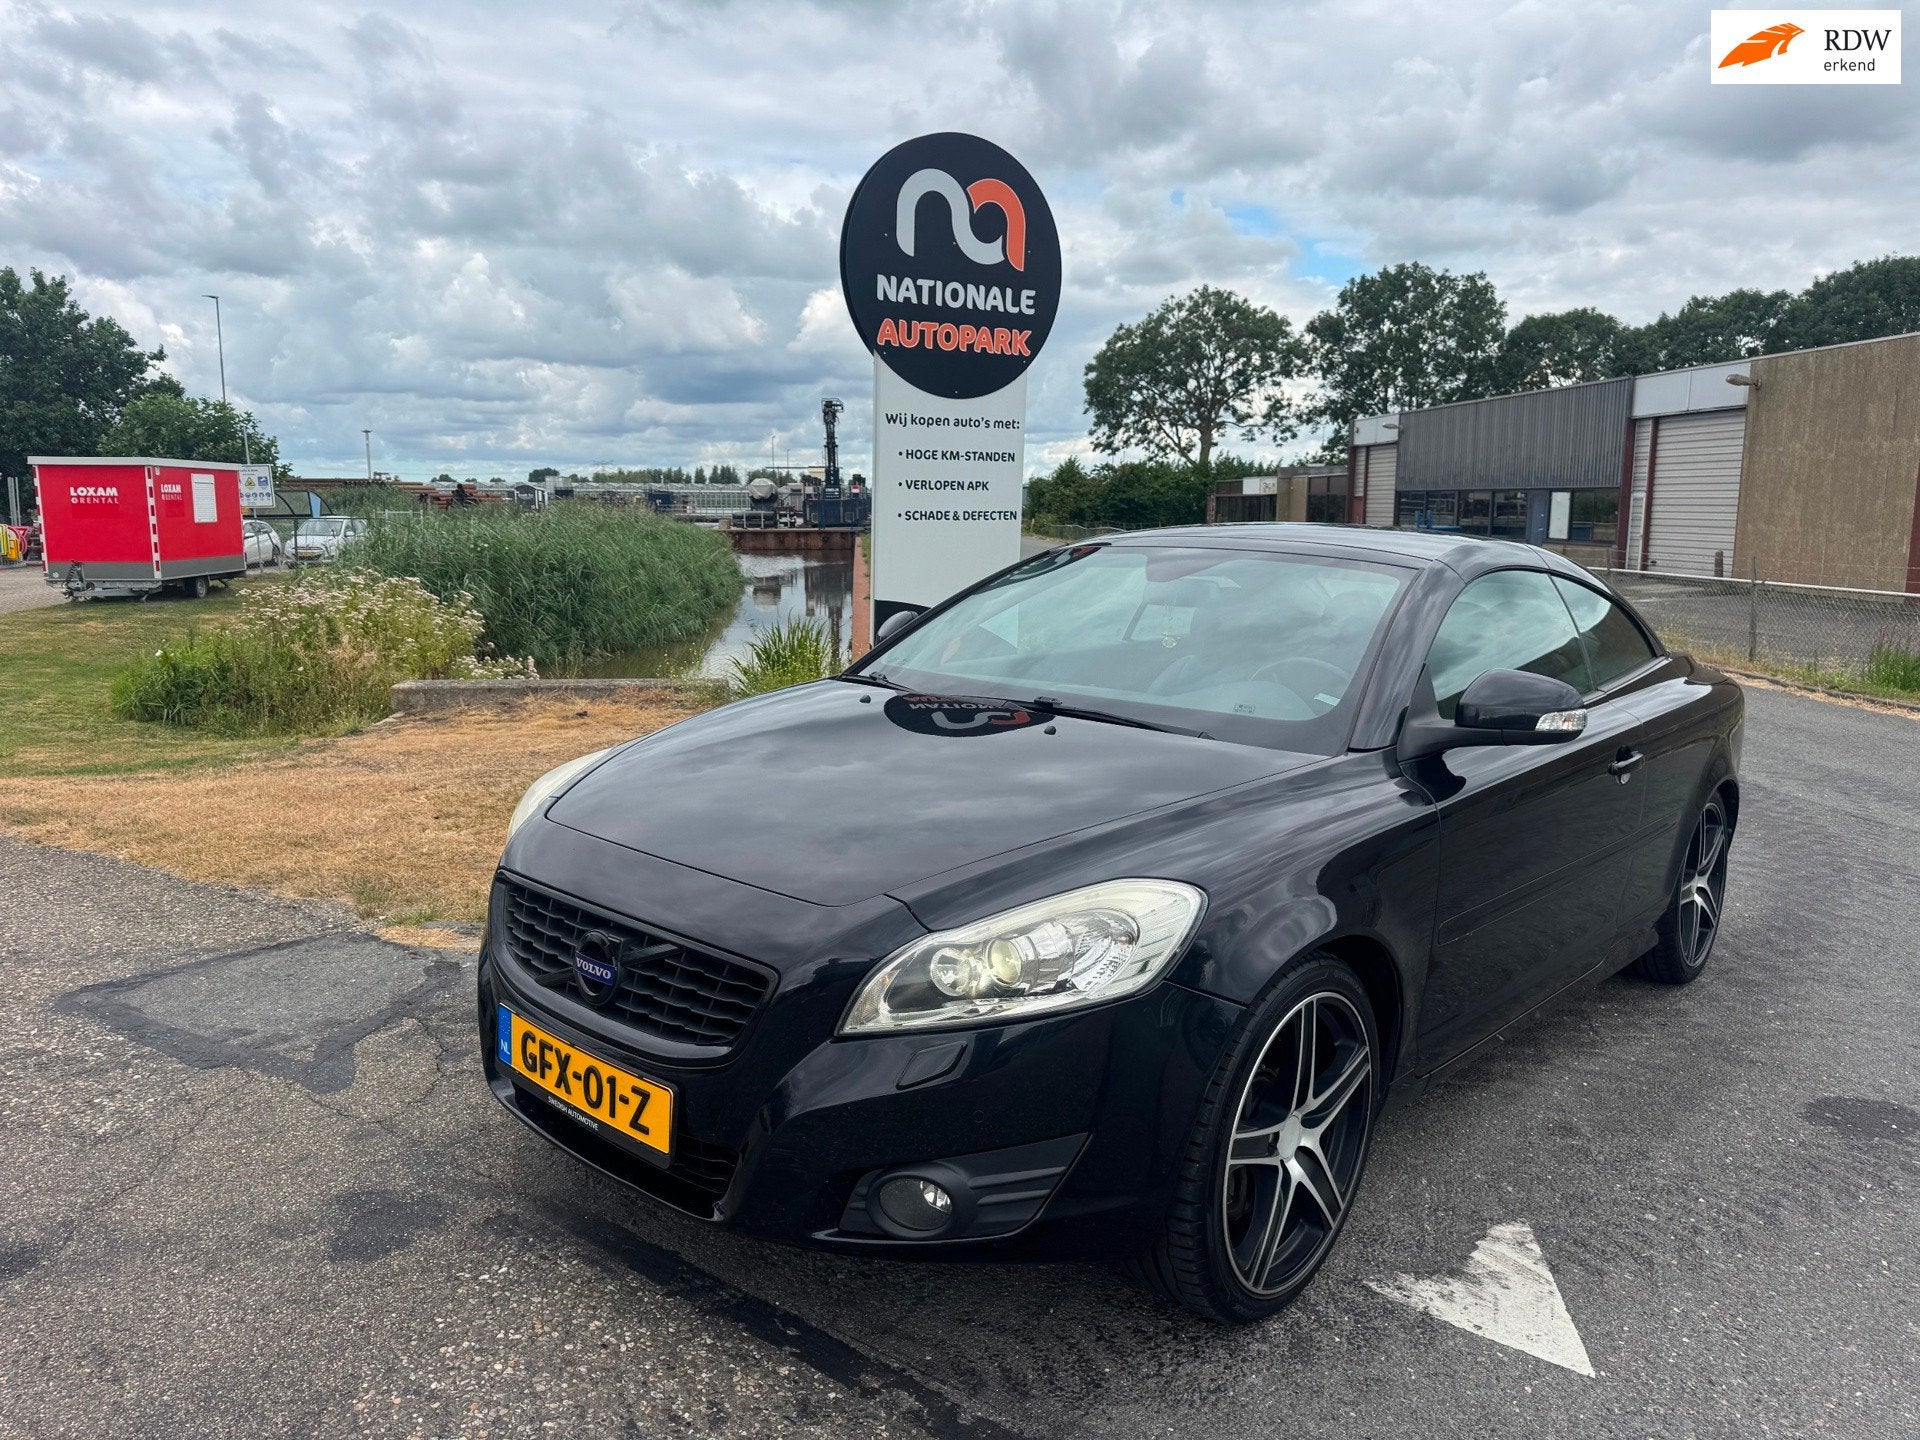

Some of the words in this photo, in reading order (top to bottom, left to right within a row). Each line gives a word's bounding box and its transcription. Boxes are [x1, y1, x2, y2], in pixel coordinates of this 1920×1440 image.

[876, 273, 1036, 315] NATIONALE
[876, 317, 1032, 357] AUTOPARK
[885, 413, 908, 427] Wij
[910, 414, 950, 428] kopen
[953, 417, 991, 429] auto's
[993, 419, 1020, 430] met:
[905, 449, 939, 460] HOGE
[941, 450, 1015, 462] KM-STANDEN
[69, 487, 118, 496] LOXAM
[160, 484, 182, 493] LOXAM
[905, 479, 965, 491] VERLOPEN
[967, 480, 989, 492] APK
[904, 510, 950, 521] SCHADE
[952, 510, 960, 521] &
[962, 510, 1017, 521] DEFECTEN
[576, 957, 611, 979] VOLVO
[500, 1038, 511, 1056] NL
[521, 1030, 652, 1135] GFX-01-Z
[567, 1109, 599, 1131] AUTOMOTIVE
